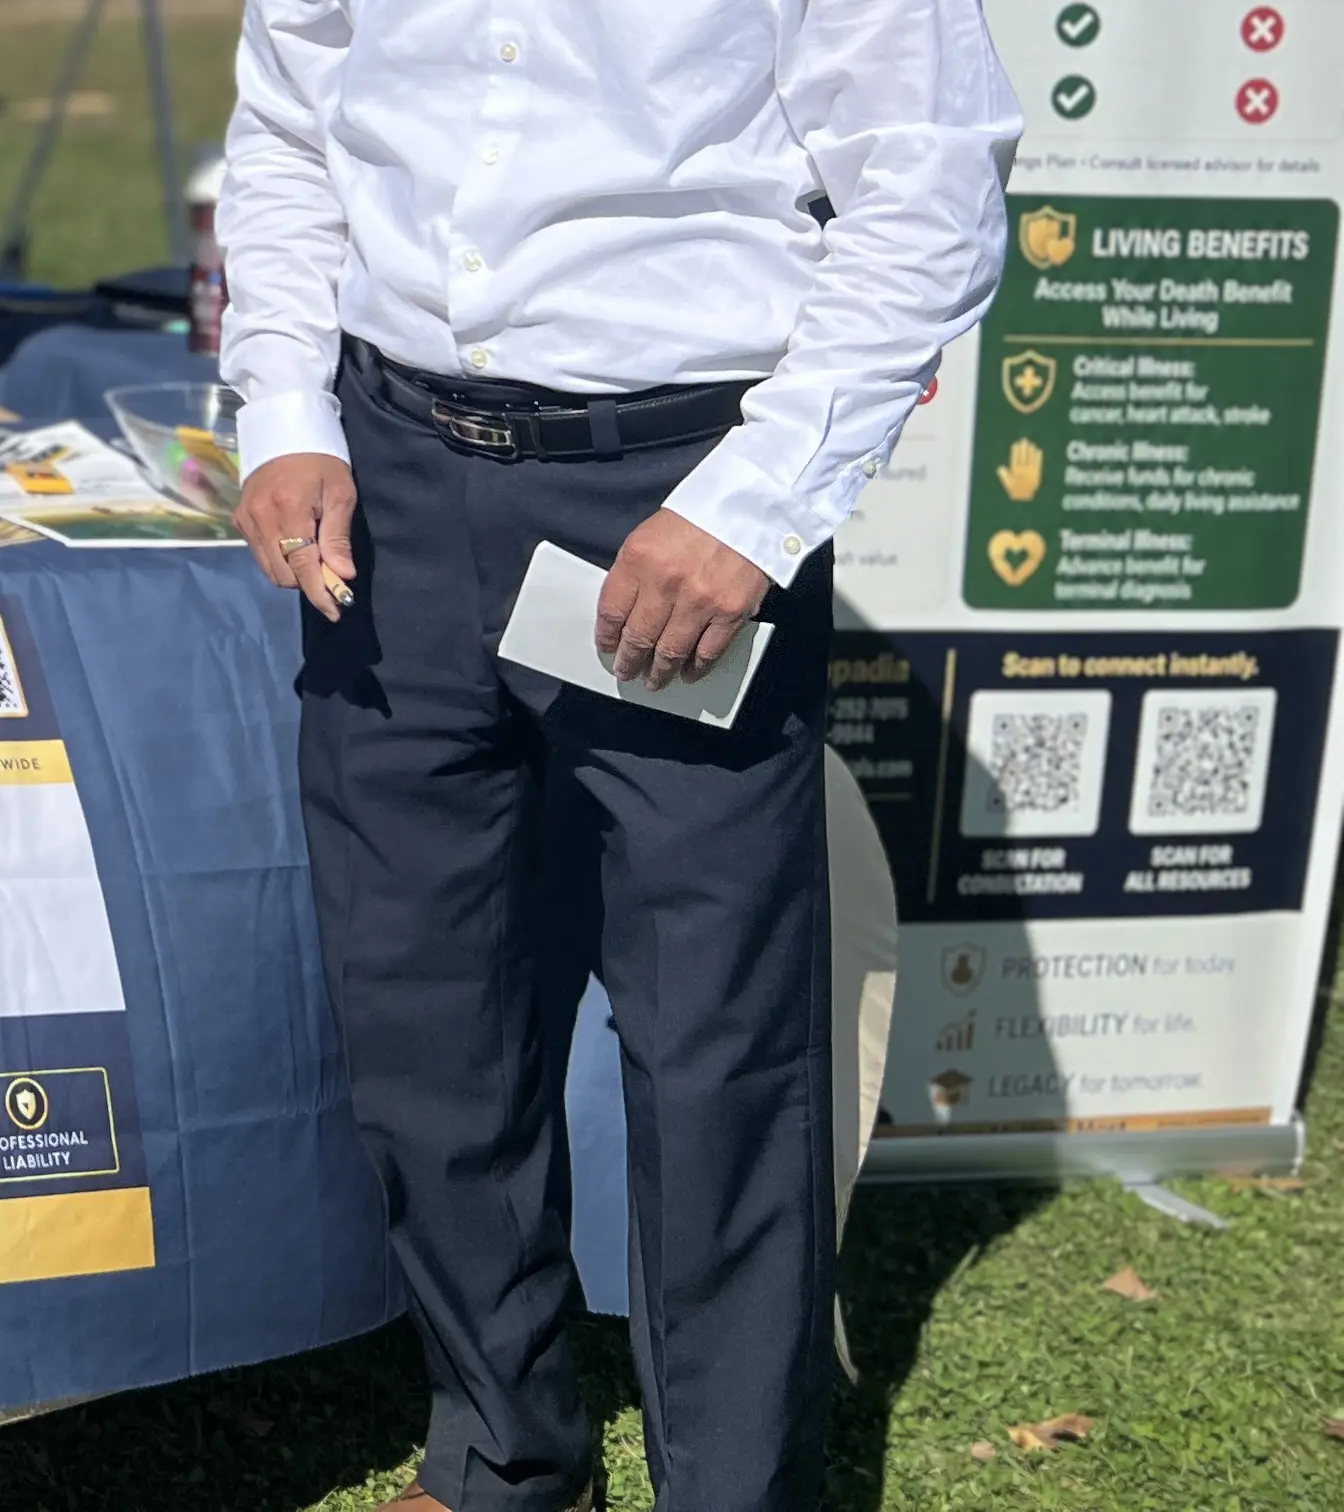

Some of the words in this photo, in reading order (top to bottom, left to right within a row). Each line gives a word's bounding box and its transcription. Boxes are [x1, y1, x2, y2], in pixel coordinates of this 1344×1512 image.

[1093, 229, 1180, 256] LIVING
[1188, 230, 1308, 259] BENEFITS
[4, 1152, 70, 1170] LIABILITY
